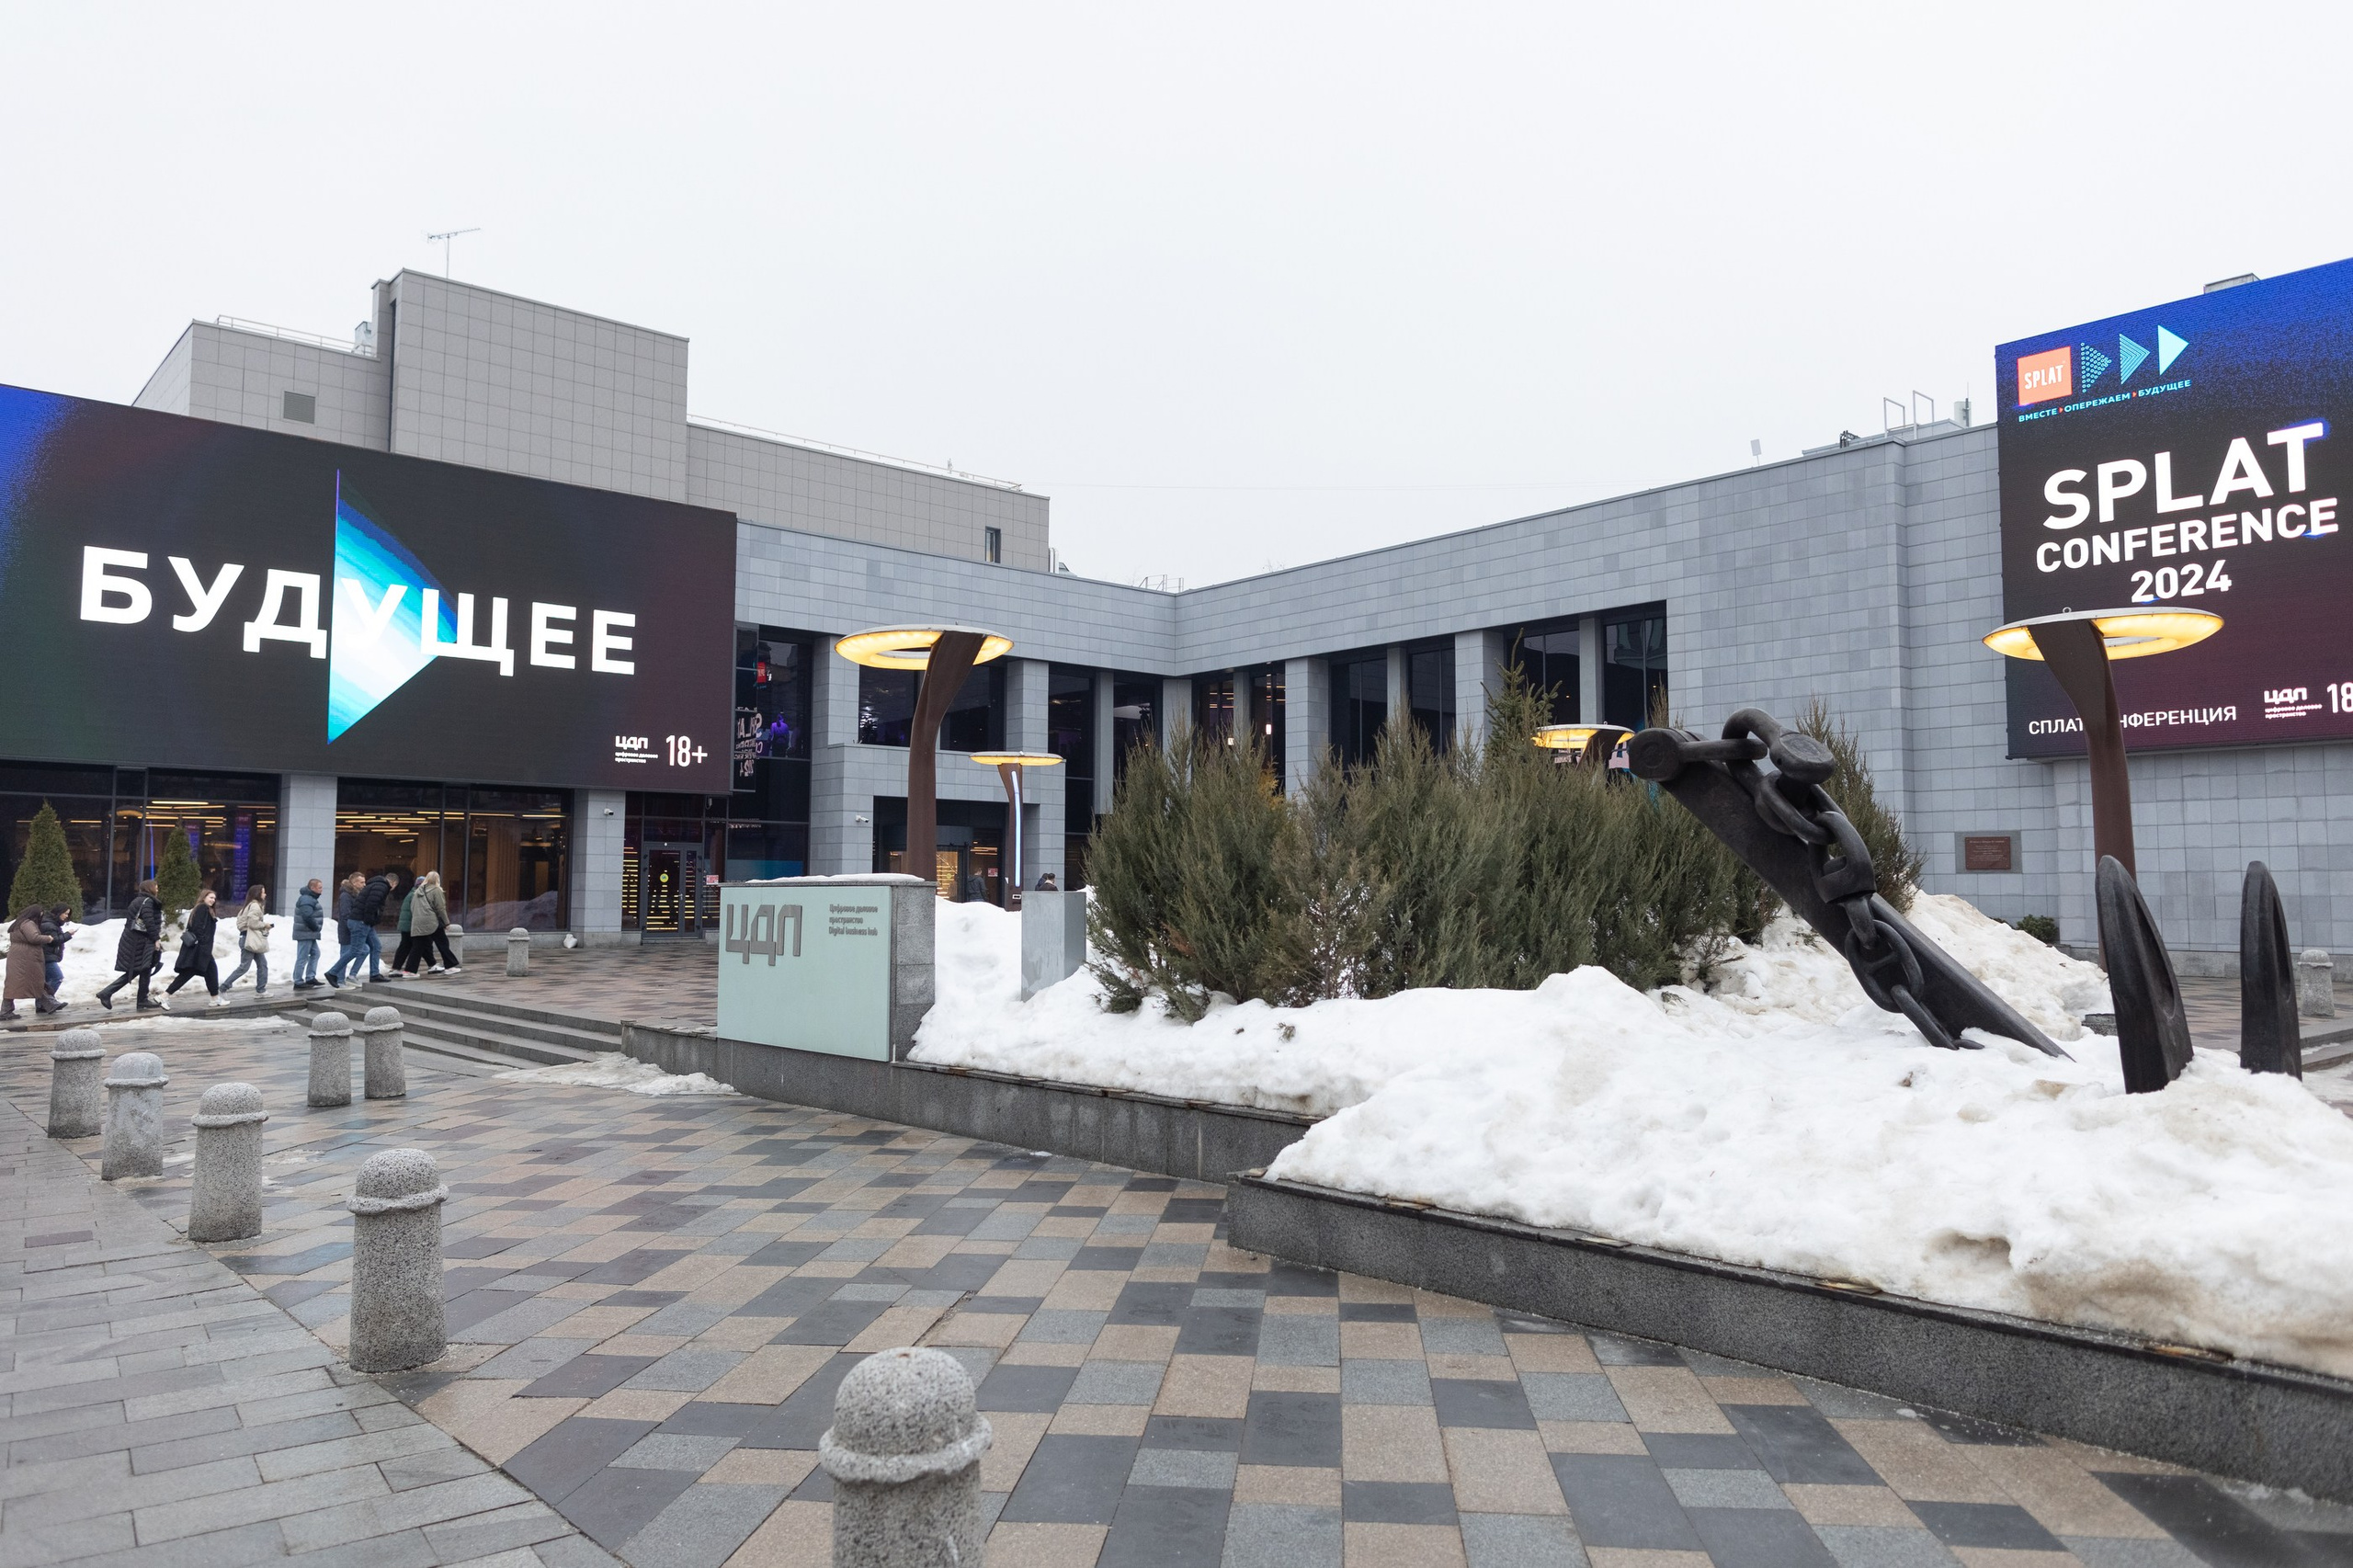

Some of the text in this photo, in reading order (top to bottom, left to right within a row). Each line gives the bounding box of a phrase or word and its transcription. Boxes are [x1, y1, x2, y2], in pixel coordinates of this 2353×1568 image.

[2024, 364, 2064, 390] SPLAT
[2018, 379, 2192, 423] ВМЕСТЕ ОПЕРЕЖАЕМ БУДУЩЕЕ
[2042, 422, 2324, 530] SPLAT
[2036, 497, 2338, 573] CONFERENCE
[2131, 559, 2233, 603] 2024
[80, 545, 636, 676] БУДУЩЕЕ
[665, 734, 708, 767] 18+
